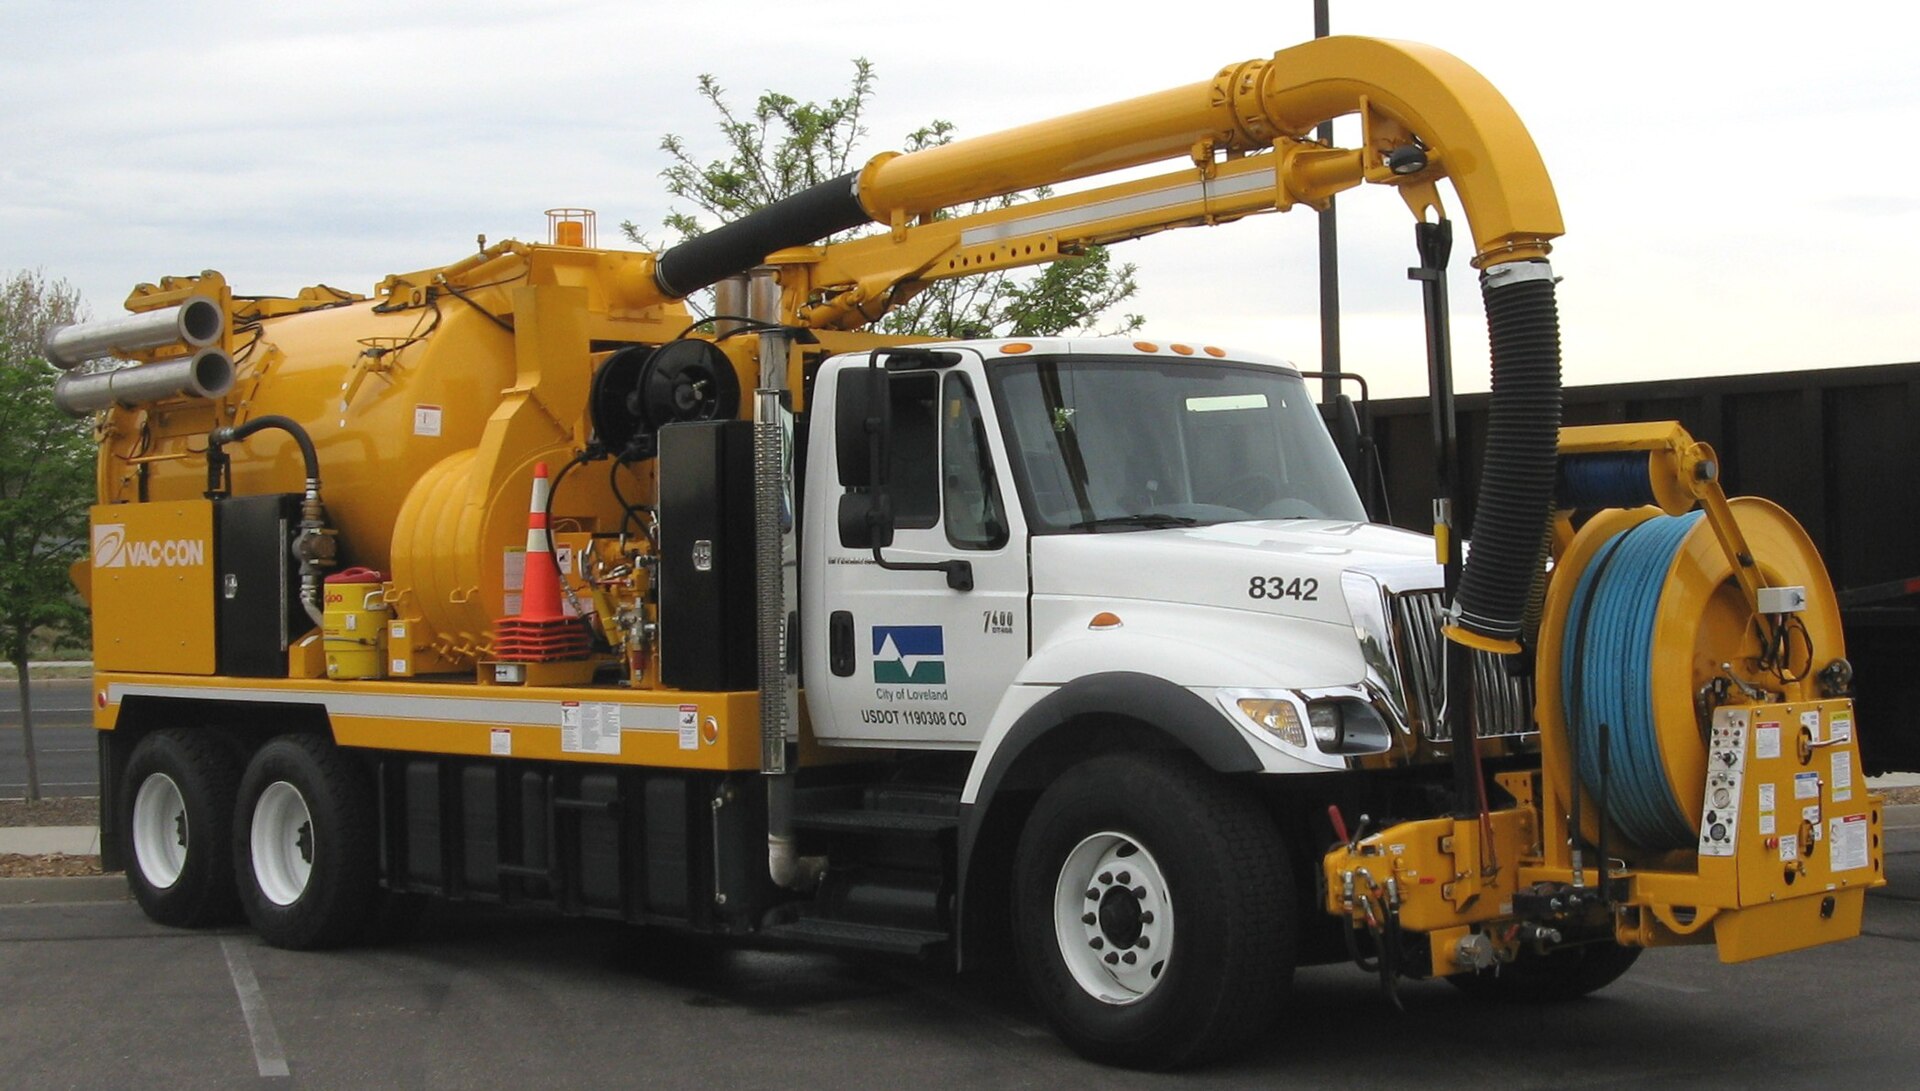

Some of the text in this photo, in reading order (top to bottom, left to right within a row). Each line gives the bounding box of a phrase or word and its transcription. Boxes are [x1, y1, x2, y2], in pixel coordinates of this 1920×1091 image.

[1248, 575, 1319, 601] 8342
[983, 610, 1013, 633] 7400
[876, 688, 948, 702] City of Loveland
[861, 709, 967, 726] USDOT 1190308 CO
